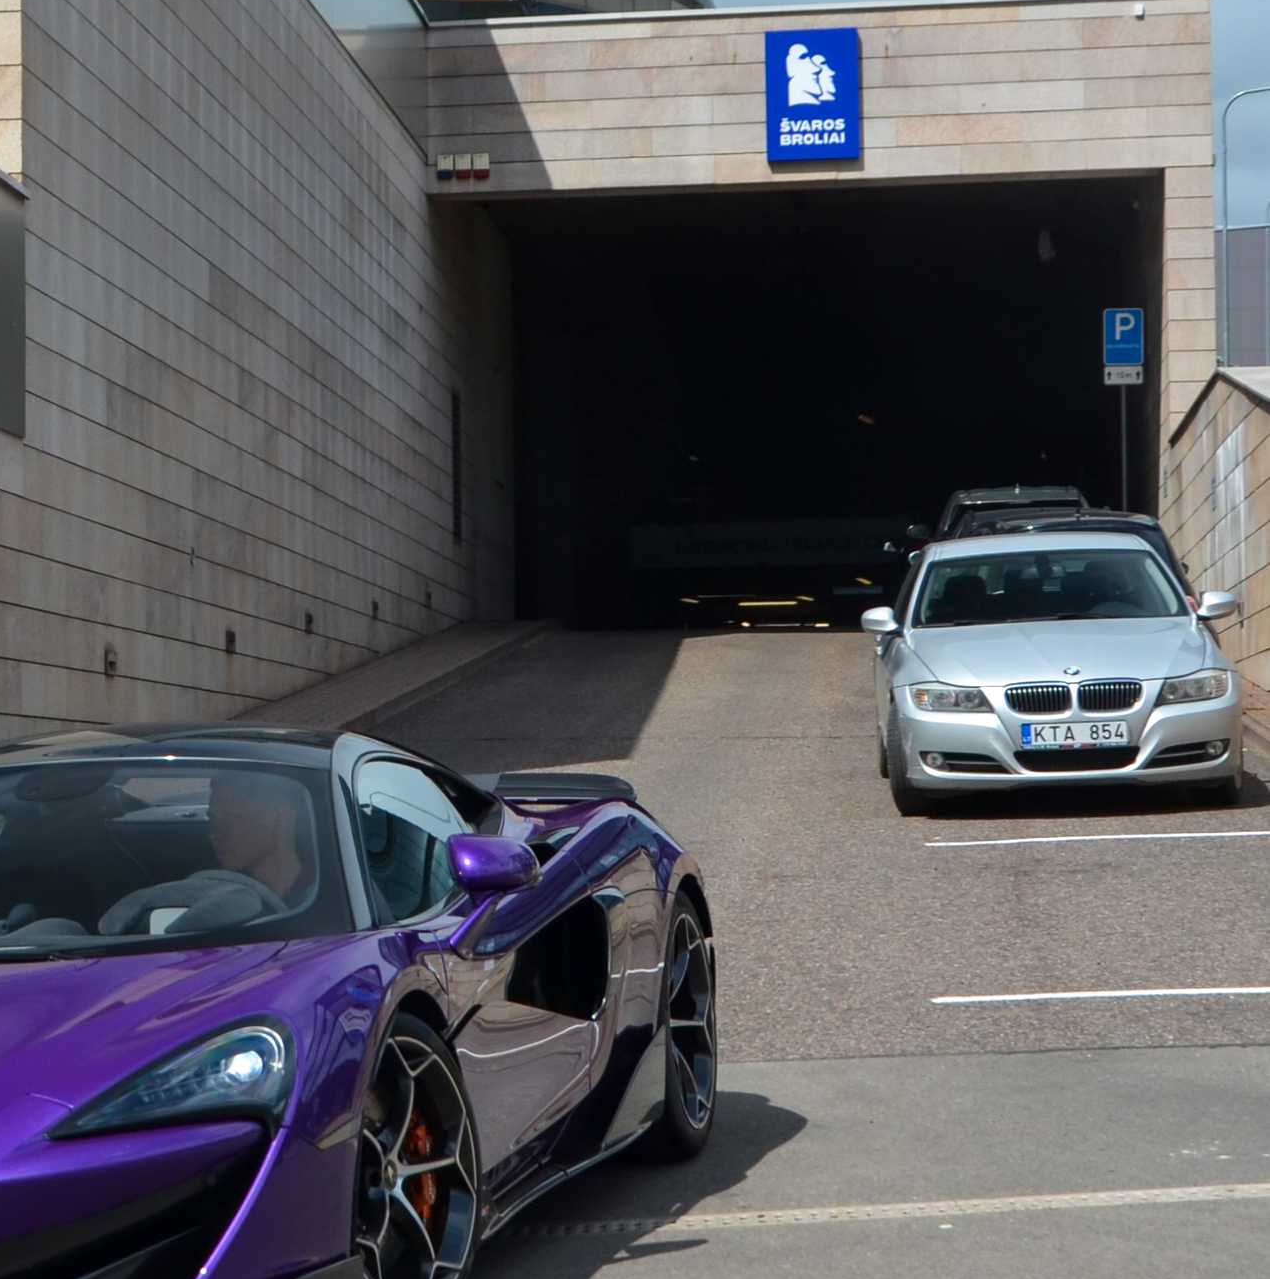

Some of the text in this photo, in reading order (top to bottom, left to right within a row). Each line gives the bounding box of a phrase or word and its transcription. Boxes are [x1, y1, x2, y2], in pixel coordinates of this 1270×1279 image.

[780, 117, 846, 132] ŠVAROS
[780, 132, 846, 146] BROLIAI
[1115, 313, 1136, 340] P
[1034, 724, 1124, 742] KTA 854
